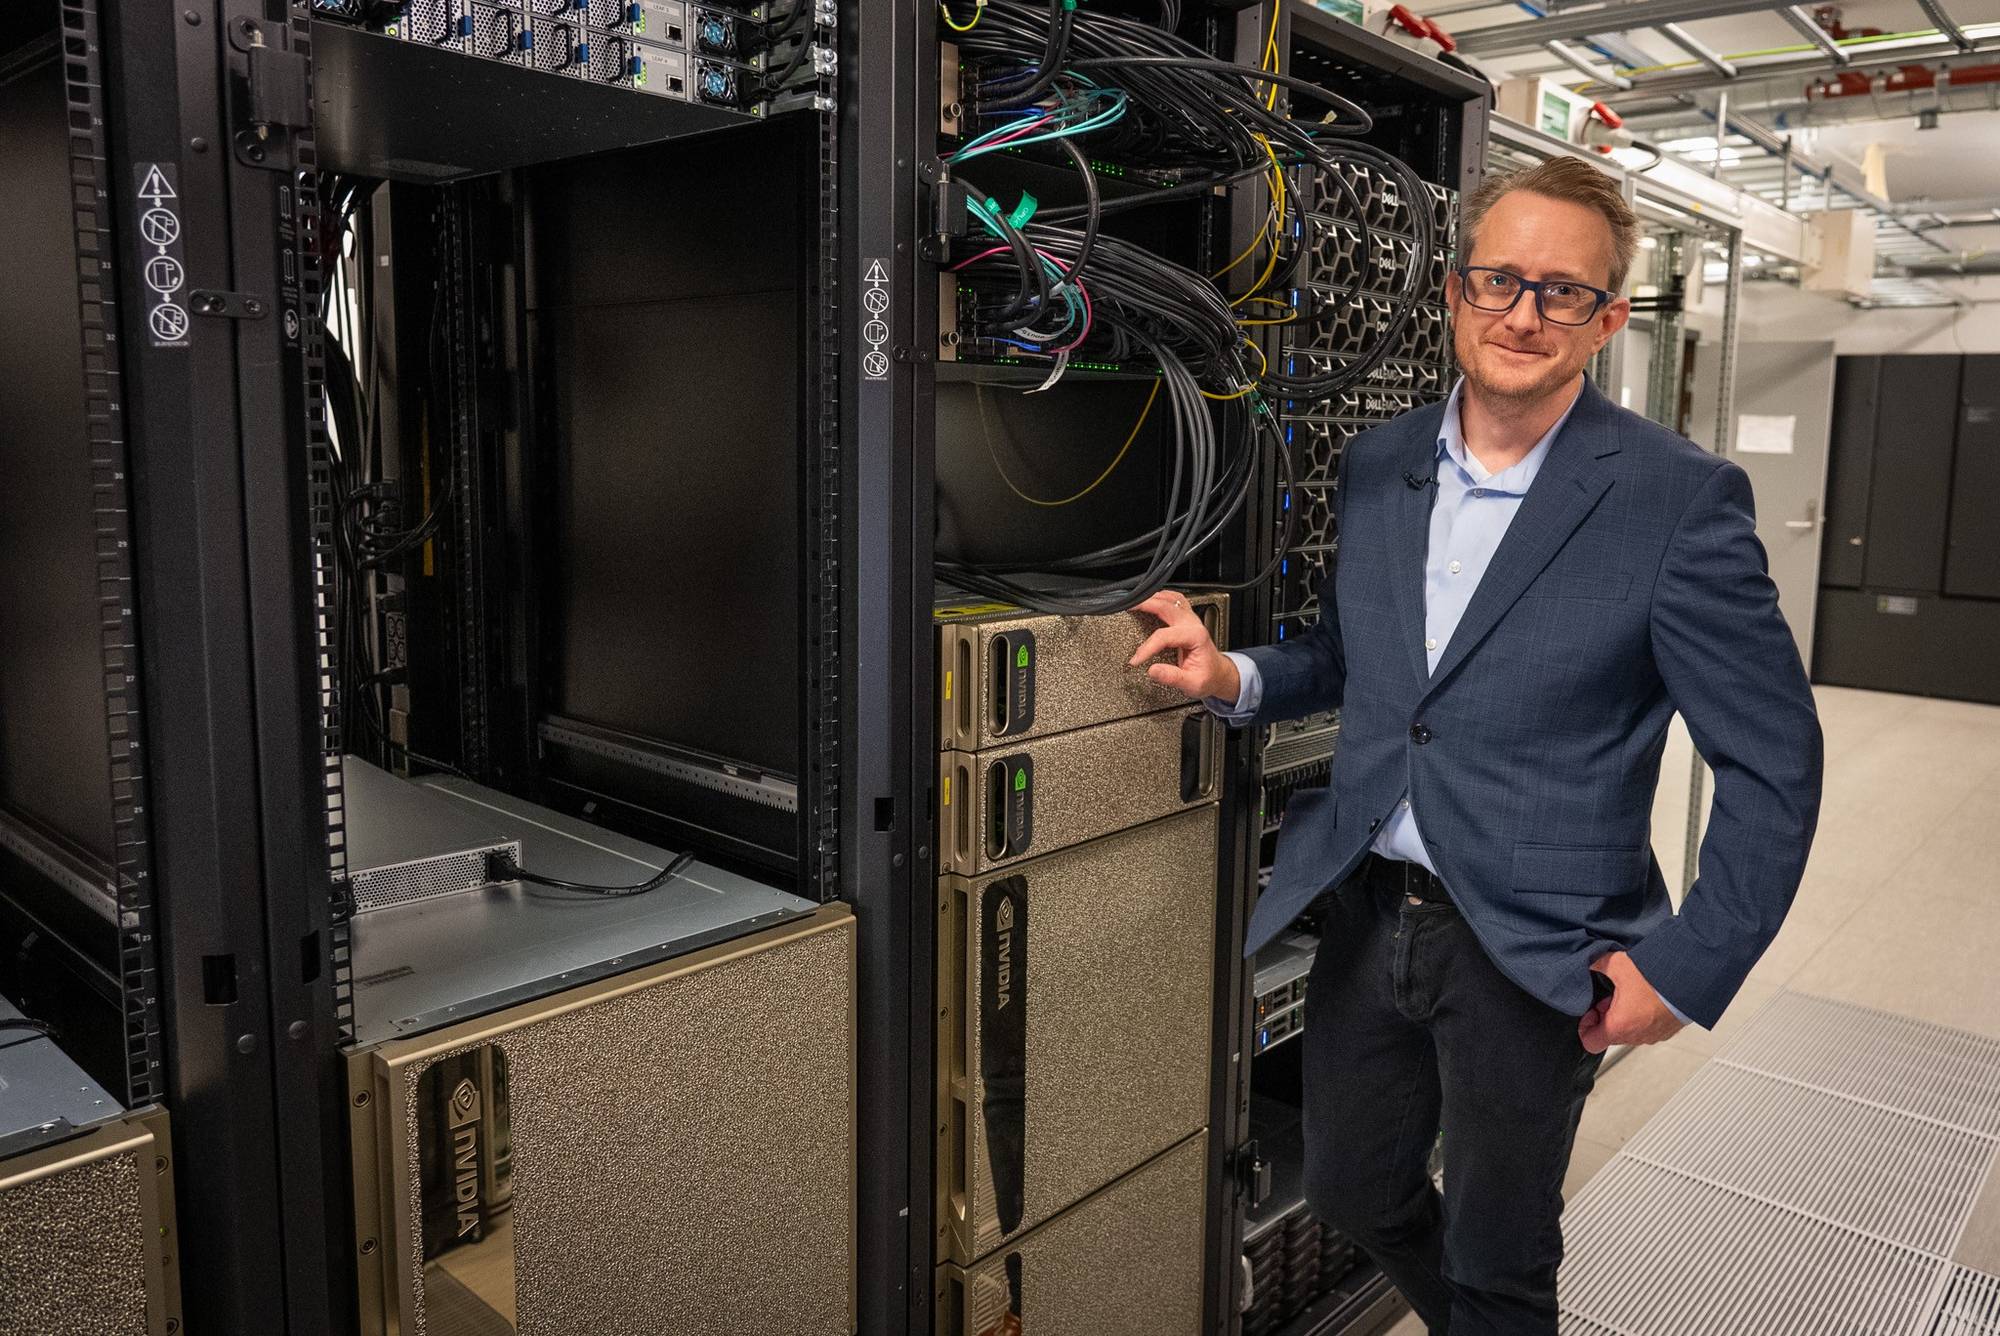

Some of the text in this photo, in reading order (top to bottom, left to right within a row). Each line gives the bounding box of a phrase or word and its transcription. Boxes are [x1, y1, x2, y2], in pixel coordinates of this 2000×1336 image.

[1017, 668, 1028, 719] NVIDIA
[1015, 791, 1026, 842] NVIDIA
[998, 931, 1011, 1011] NVIDIA
[454, 1126, 480, 1238] NVIDIA
